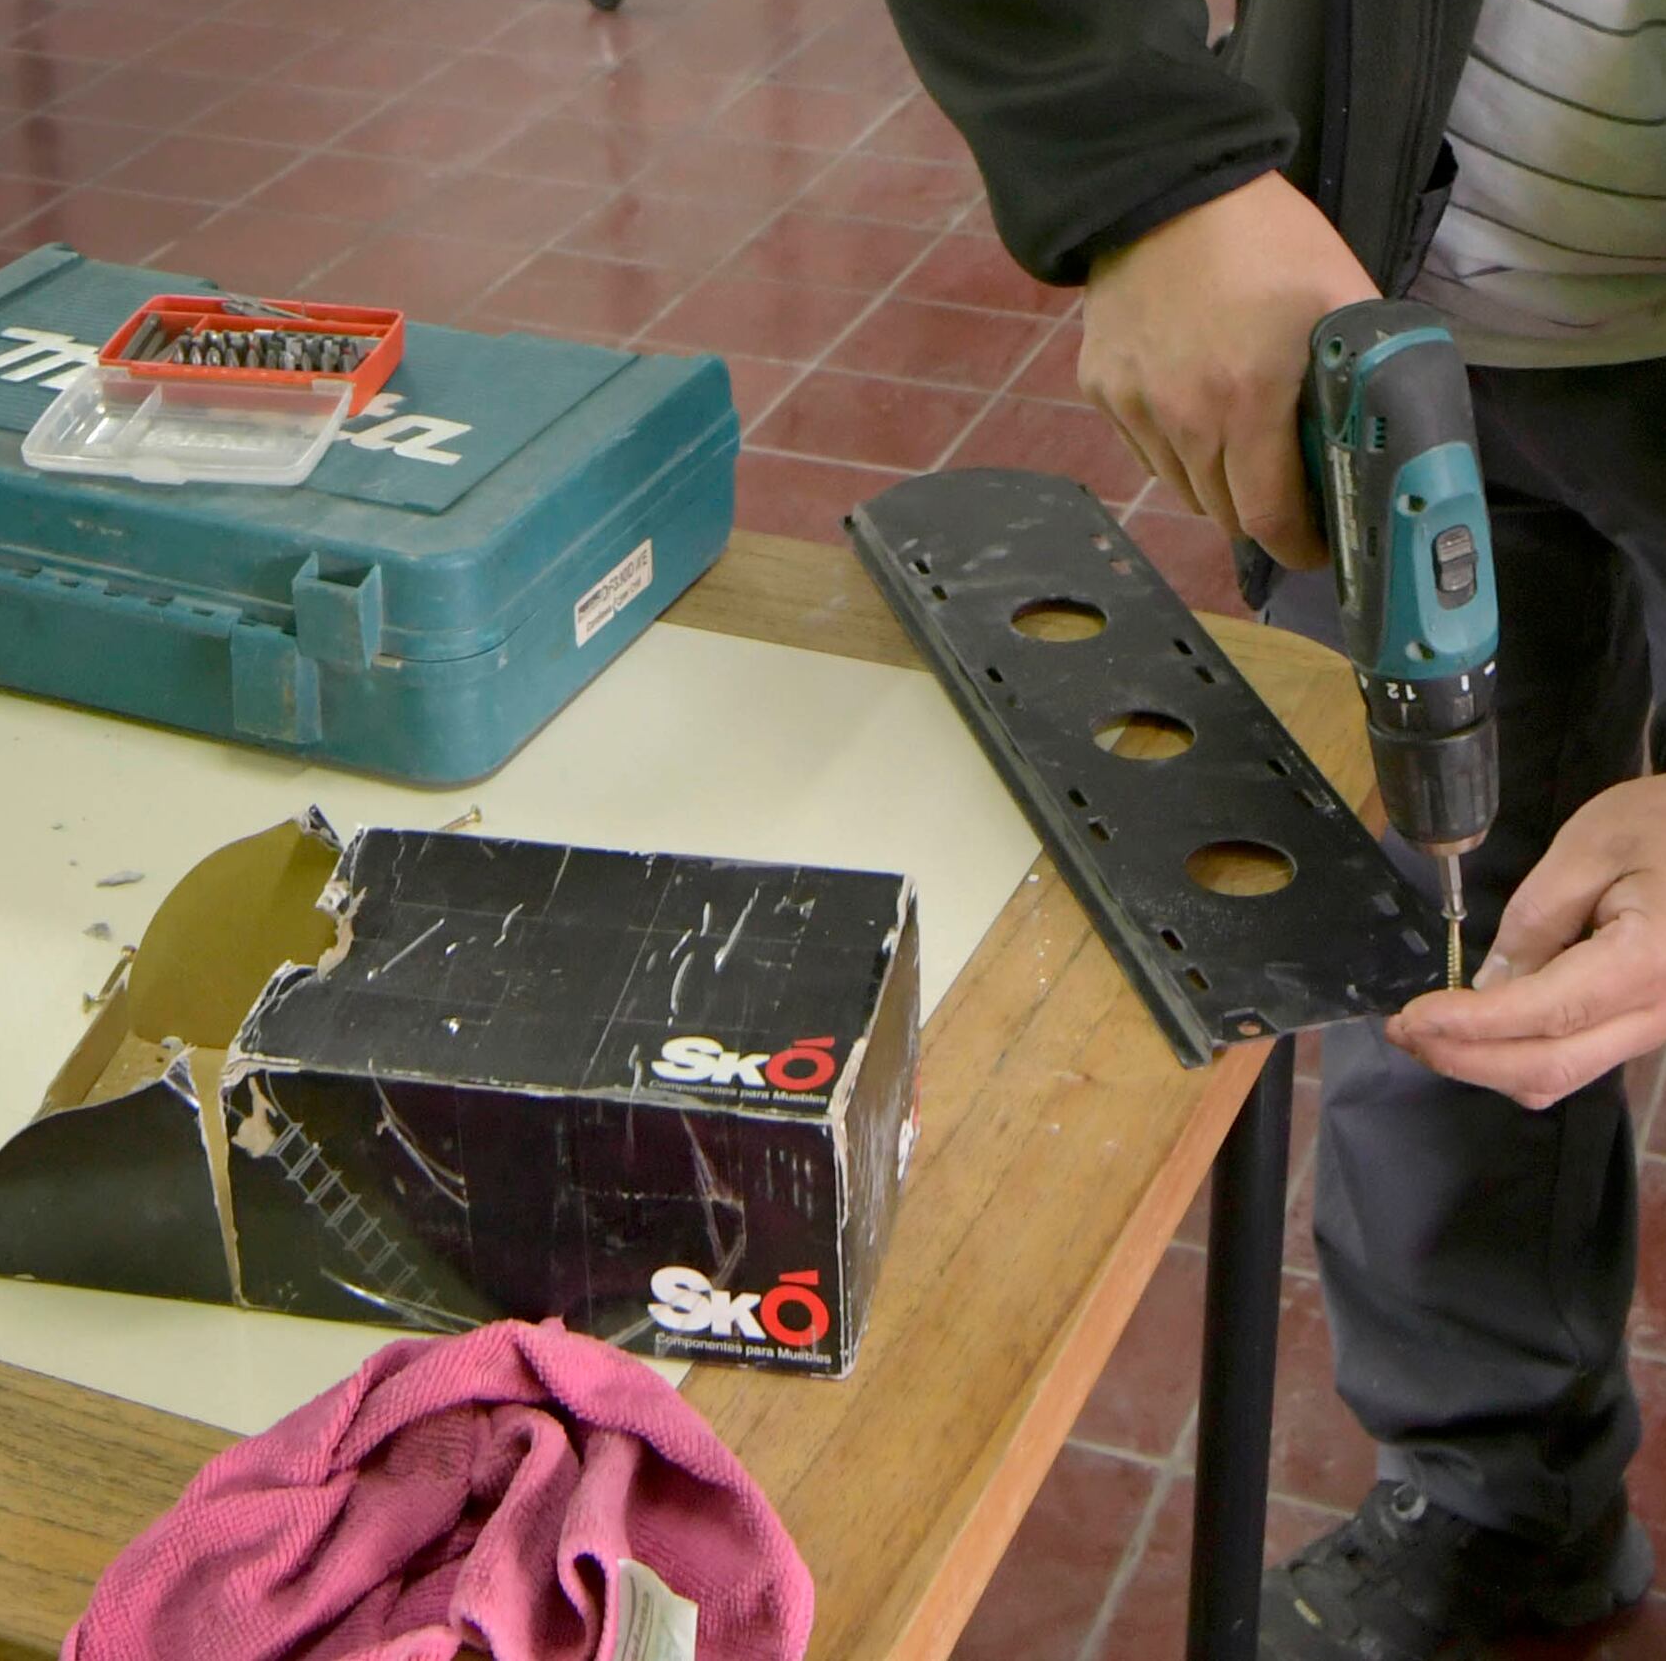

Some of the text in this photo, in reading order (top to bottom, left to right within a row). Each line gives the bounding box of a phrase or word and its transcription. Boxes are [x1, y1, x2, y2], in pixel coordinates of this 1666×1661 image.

[649, 1080, 827, 1105] Componentes para Muebles
[655, 1332, 832, 1365] Componentes para Muebles
